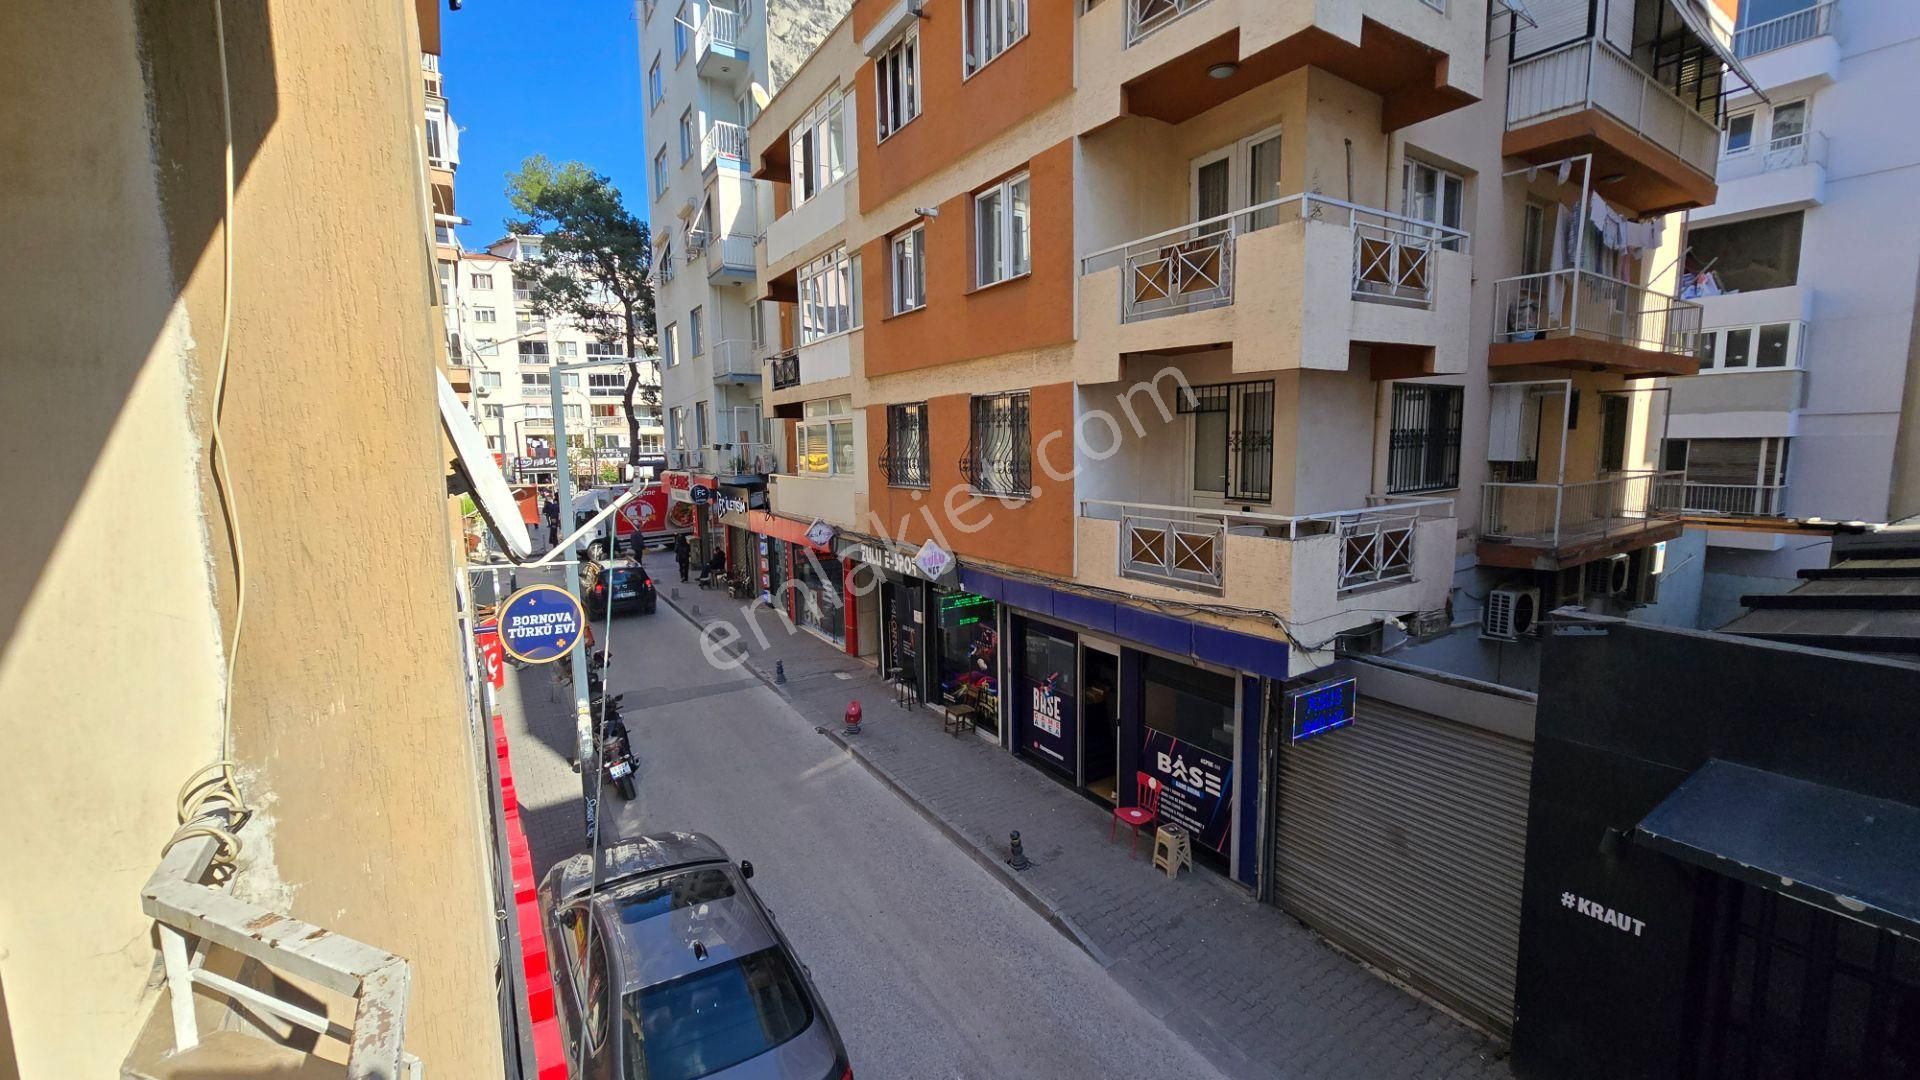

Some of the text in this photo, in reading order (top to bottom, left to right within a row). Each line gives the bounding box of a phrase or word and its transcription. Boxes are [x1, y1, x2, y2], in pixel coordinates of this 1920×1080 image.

[860, 544, 882, 566] ZULU
[928, 565, 940, 575] NET
[508, 620, 576, 638] TÜRKÜ EVİ
[512, 612, 572, 627] BORNOVA
[1033, 687, 1061, 720] BASE
[1157, 751, 1221, 797] BASE
[1561, 891, 1646, 937] #KRAUT
